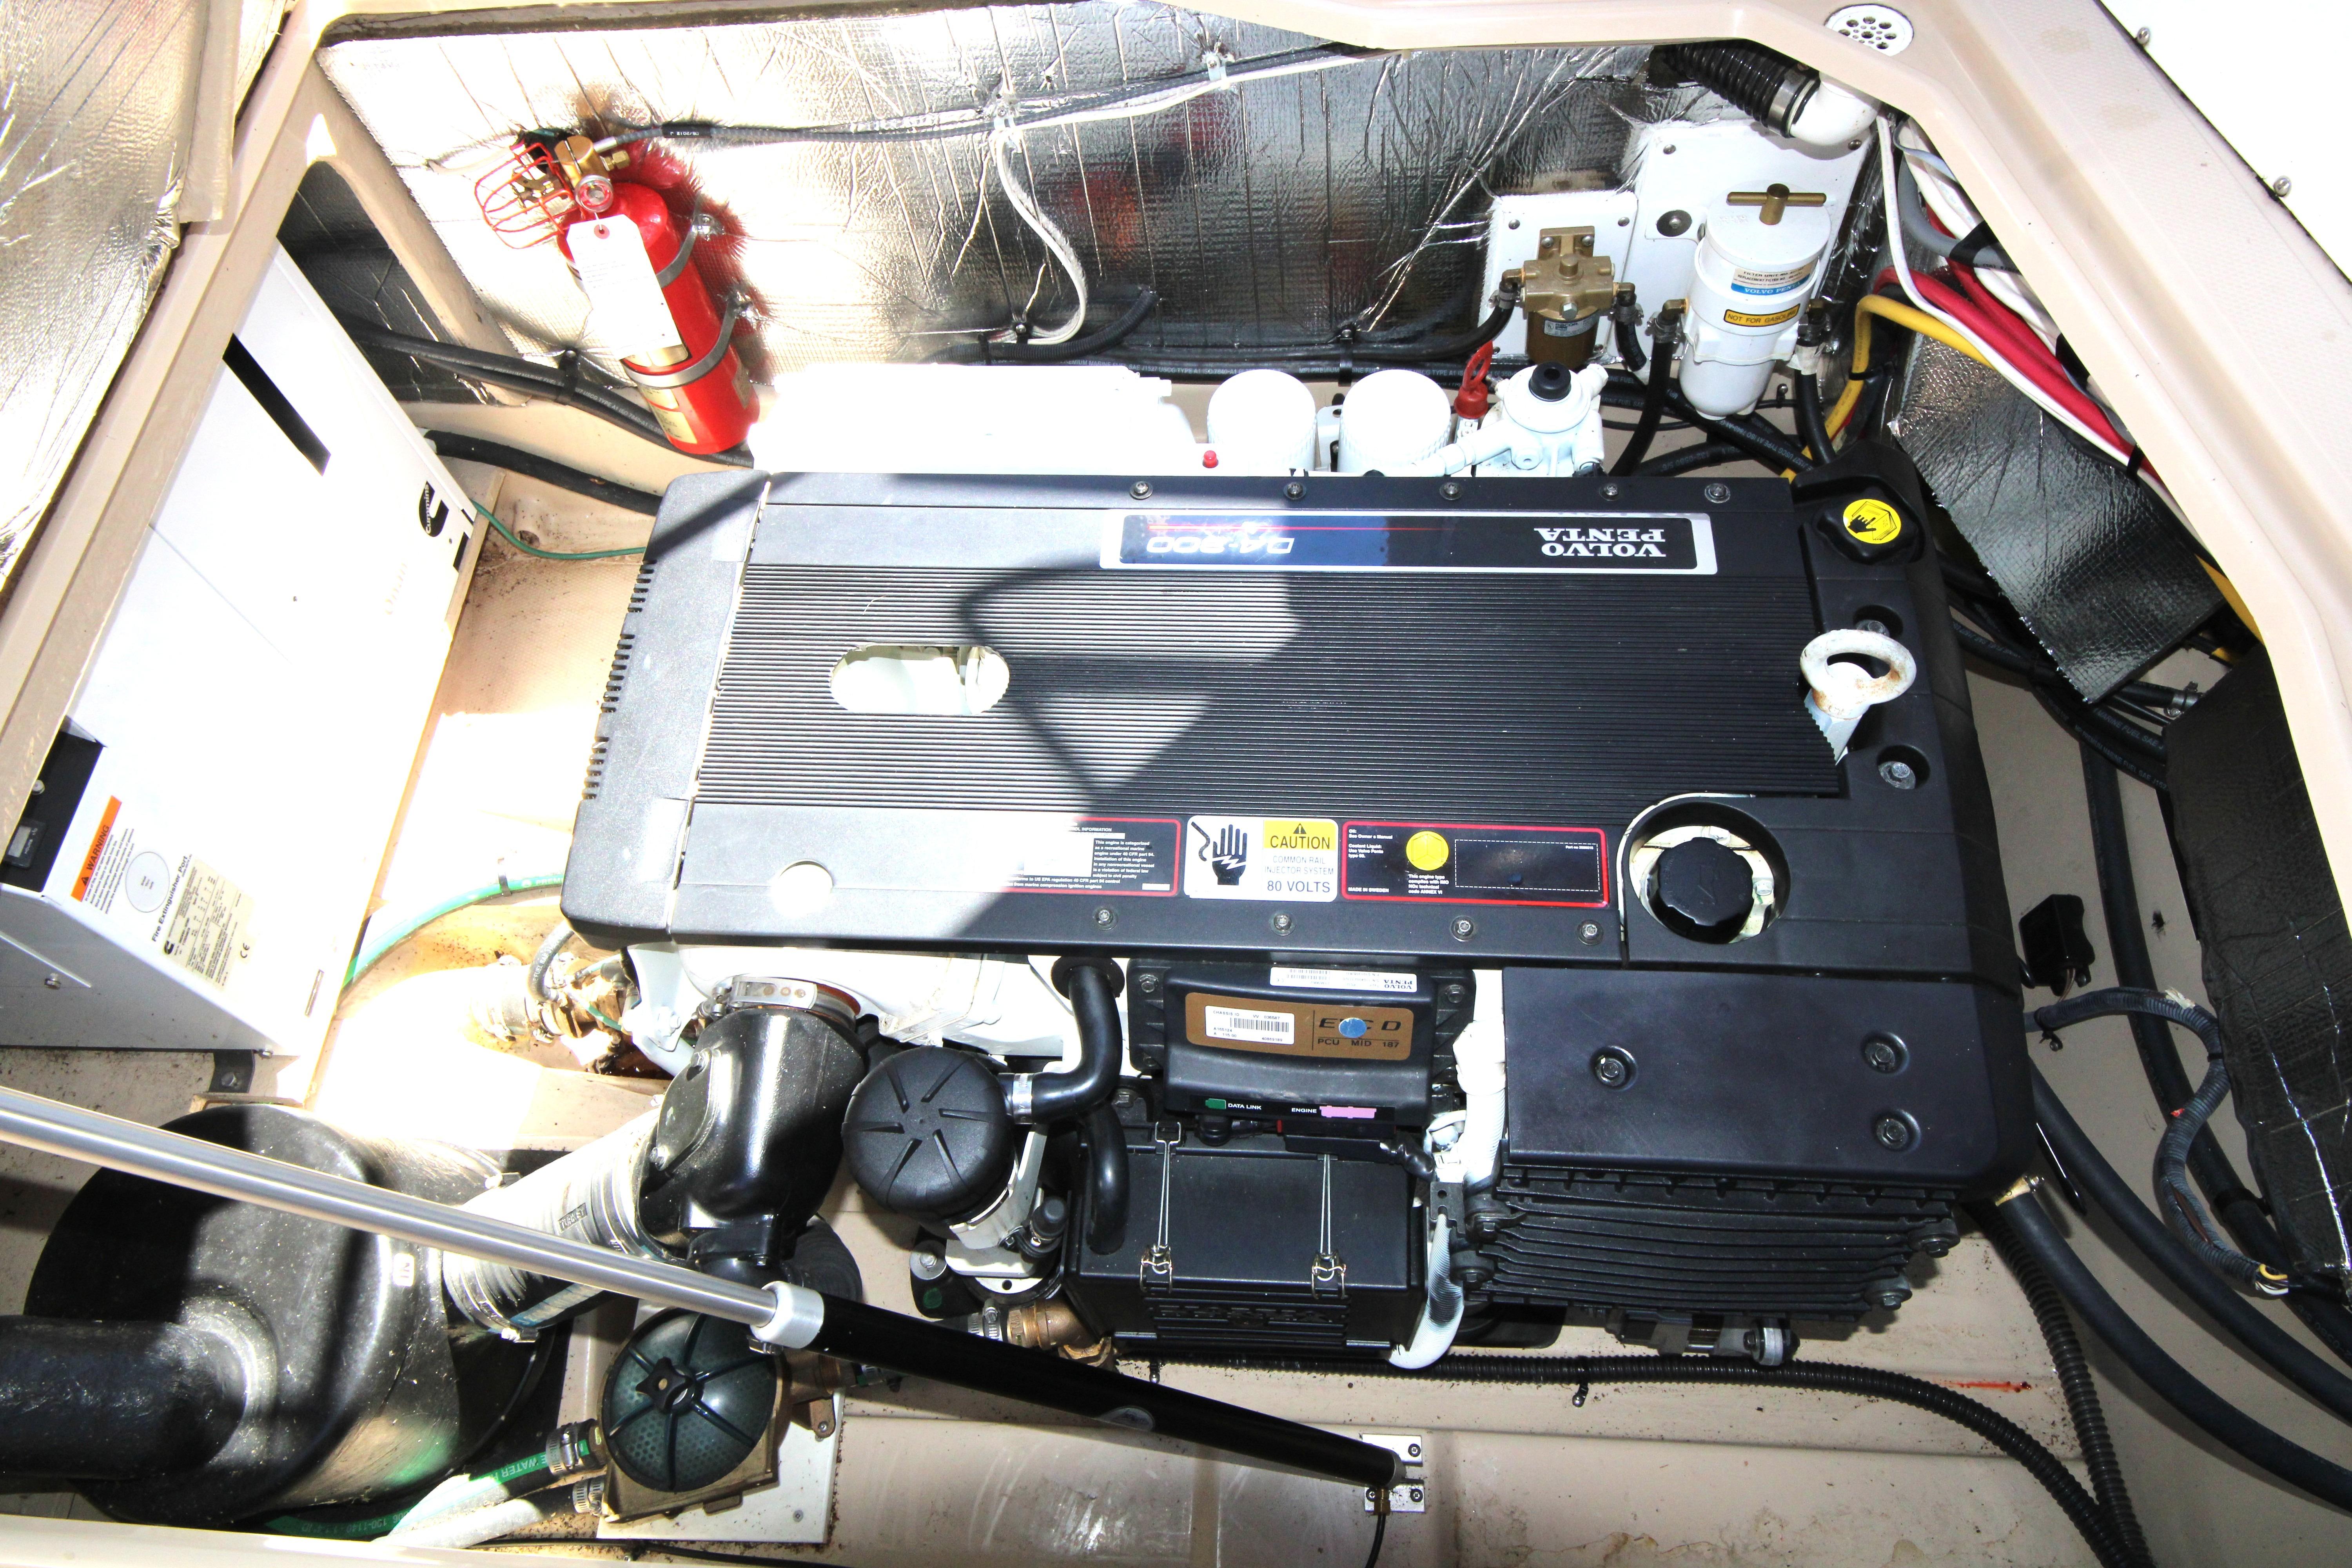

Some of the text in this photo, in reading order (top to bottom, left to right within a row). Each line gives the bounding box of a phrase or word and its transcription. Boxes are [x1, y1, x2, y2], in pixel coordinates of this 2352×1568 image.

[1776, 282, 1800, 292] PENTA
[1765, 310, 1797, 323] GASOLINE
[522, 372, 543, 381] MARINE
[1763, 439, 1779, 452] TYPE
[1777, 447, 1794, 460] USCG
[1534, 528, 1666, 542] PENTA
[1541, 543, 1666, 557] VOLVO
[2122, 725, 2140, 739] FUEL
[86, 824, 110, 871] WARNING
[1270, 835, 1330, 849] CAUTION
[1273, 855, 1306, 864] COMMON
[1267, 880, 1330, 893] 80 VOLTS
[151, 855, 188, 942] Fire Extinguisher Port
[1381, 1021, 1401, 1031] D
[501, 1457, 537, 1477] WATER
